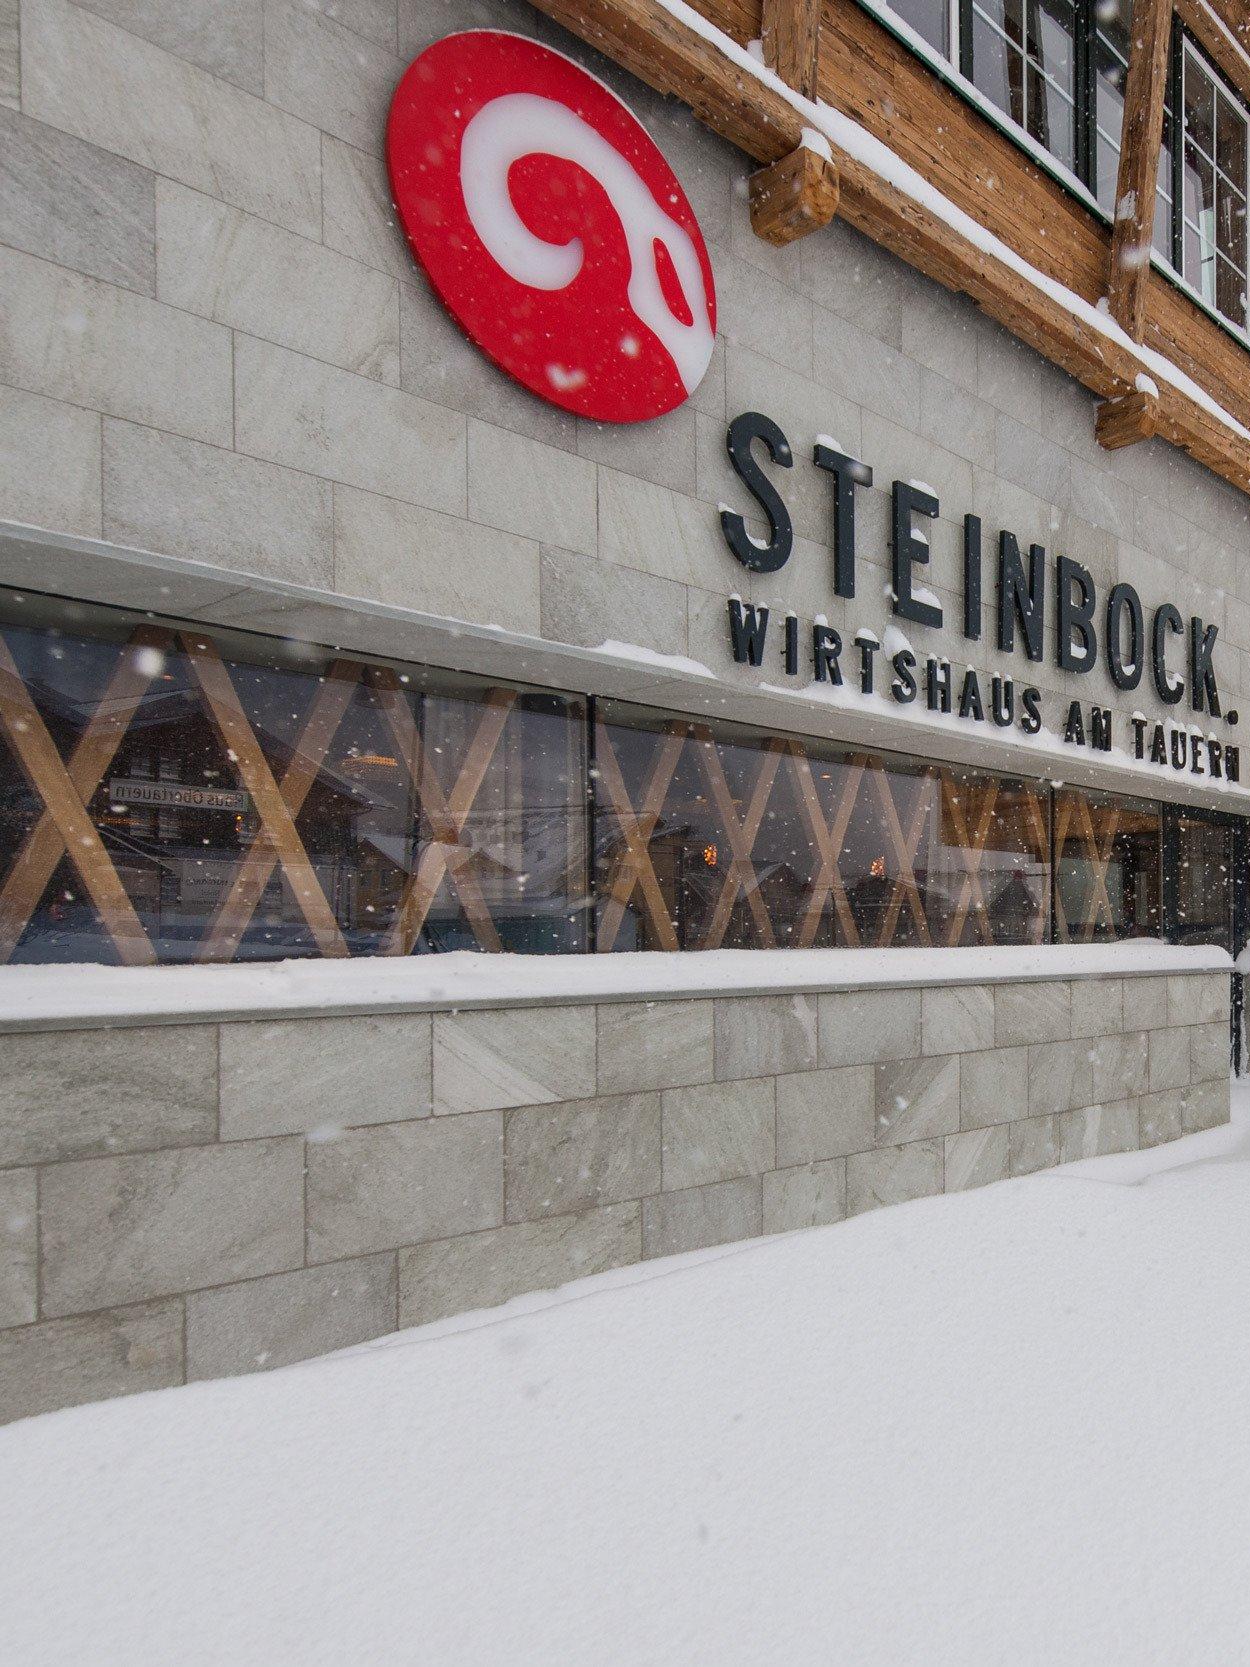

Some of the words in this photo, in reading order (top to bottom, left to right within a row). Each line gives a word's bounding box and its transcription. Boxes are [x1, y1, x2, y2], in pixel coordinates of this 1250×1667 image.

[720, 411, 1239, 725] STEINBOCK.
[729, 598, 1042, 734] WIRTSHAUS
[1064, 700, 1112, 752] AN
[1131, 717, 1240, 782] TAUERN
